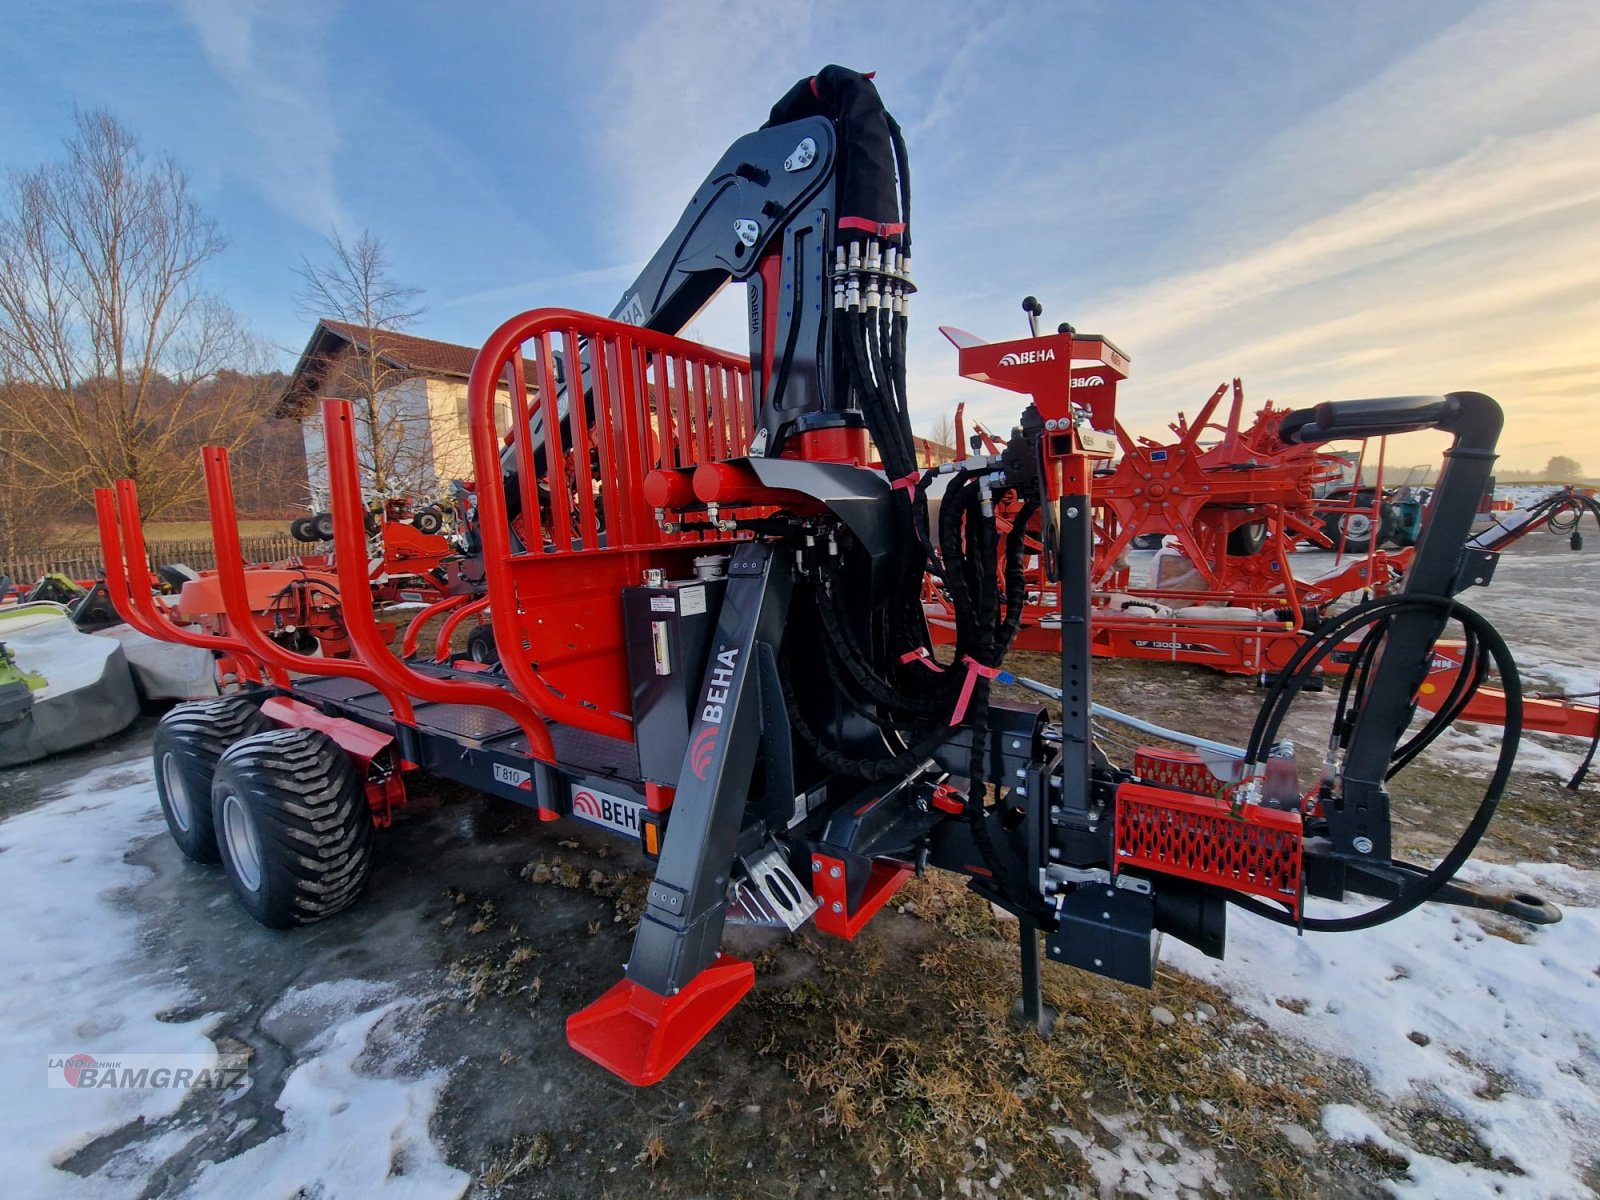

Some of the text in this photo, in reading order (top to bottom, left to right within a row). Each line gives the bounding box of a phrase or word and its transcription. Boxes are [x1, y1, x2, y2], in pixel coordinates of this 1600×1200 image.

[751, 303, 760, 335] BEHA
[1020, 349, 1055, 364] BEHA
[494, 765, 520, 784] T 810
[601, 798, 640, 832] BEH
